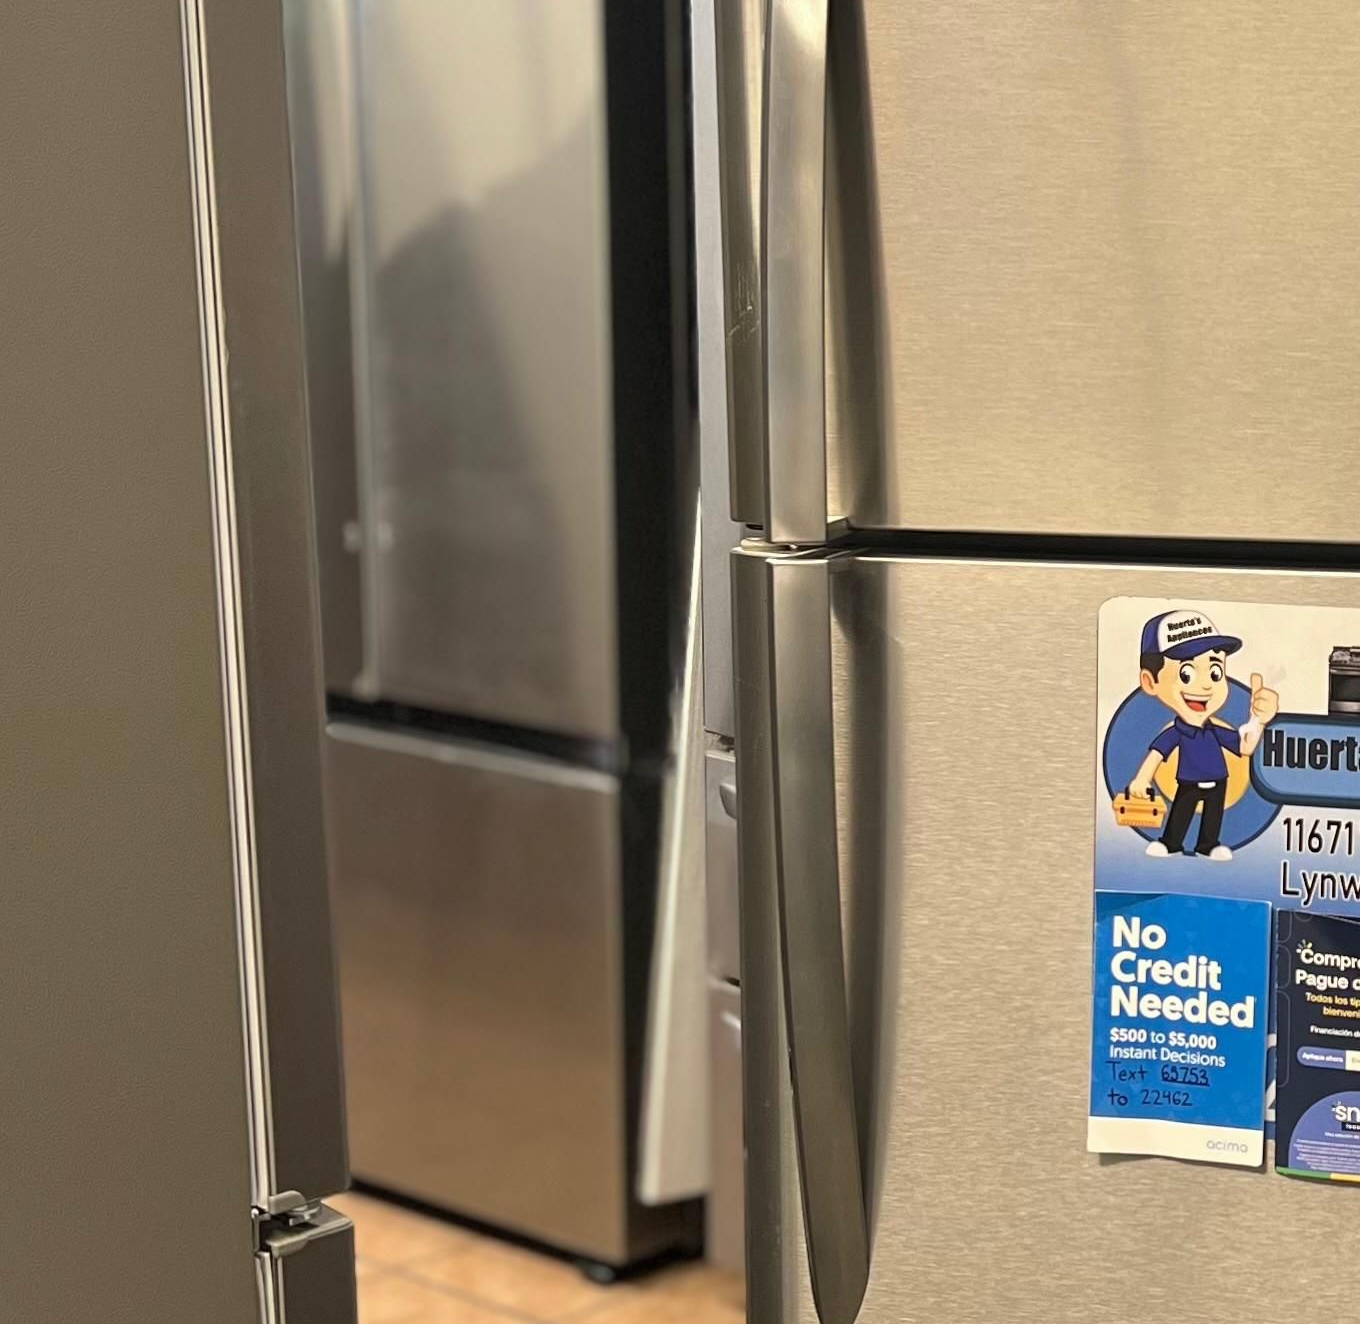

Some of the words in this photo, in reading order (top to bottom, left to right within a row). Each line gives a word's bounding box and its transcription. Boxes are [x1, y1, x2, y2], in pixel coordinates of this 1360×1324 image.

[1167, 617, 1202, 631] Huerta's
[1167, 626, 1213, 643] Appliances
[1282, 817, 1353, 855] 11671
[1112, 915, 1167, 949] No
[1110, 950, 1221, 991] Credit
[1295, 969, 1349, 992] Pague
[1110, 984, 1255, 1029] Needed
[1305, 992, 1333, 1005] Todos
[1335, 994, 1349, 1006] los
[1110, 1028, 1147, 1043] $500
[1150, 1030, 1166, 1044] to
[1168, 1031, 1217, 1049] $5,000
[1110, 1045, 1157, 1060] Instant
[1161, 1047, 1226, 1067] Decisions
[1106, 1061, 1148, 1081] Text
[1108, 1088, 1129, 1106] to
[1206, 1138, 1249, 1154] acima
